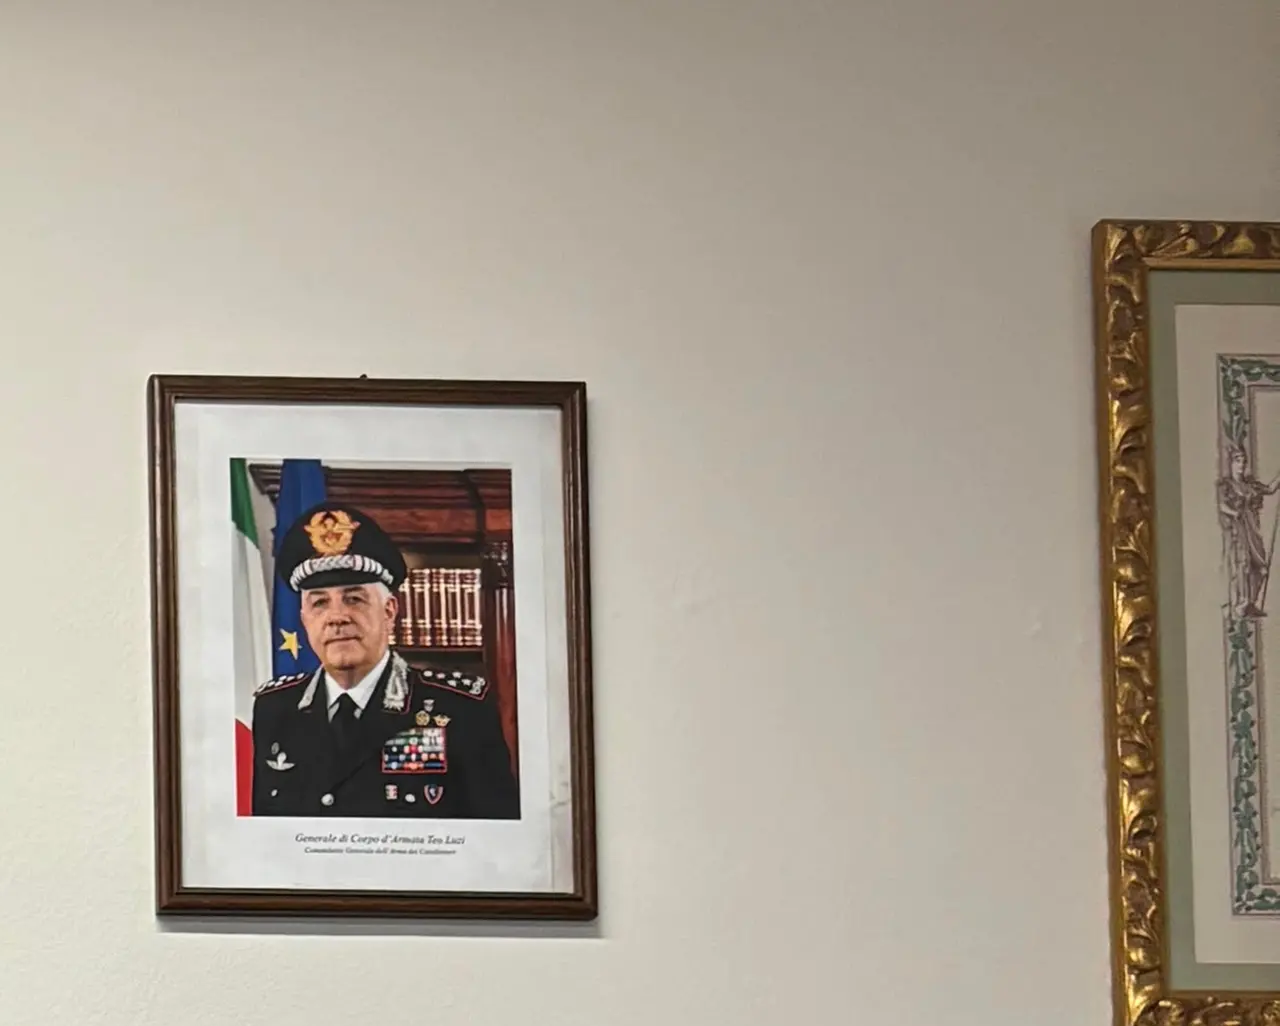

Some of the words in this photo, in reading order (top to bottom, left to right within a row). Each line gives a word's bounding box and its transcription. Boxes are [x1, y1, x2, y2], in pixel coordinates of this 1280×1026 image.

[294, 832, 338, 844] Generale
[338, 833, 348, 843] di
[350, 834, 380, 846] Corpo
[426, 835, 444, 845] Teo
[445, 835, 466, 846] Luzi
